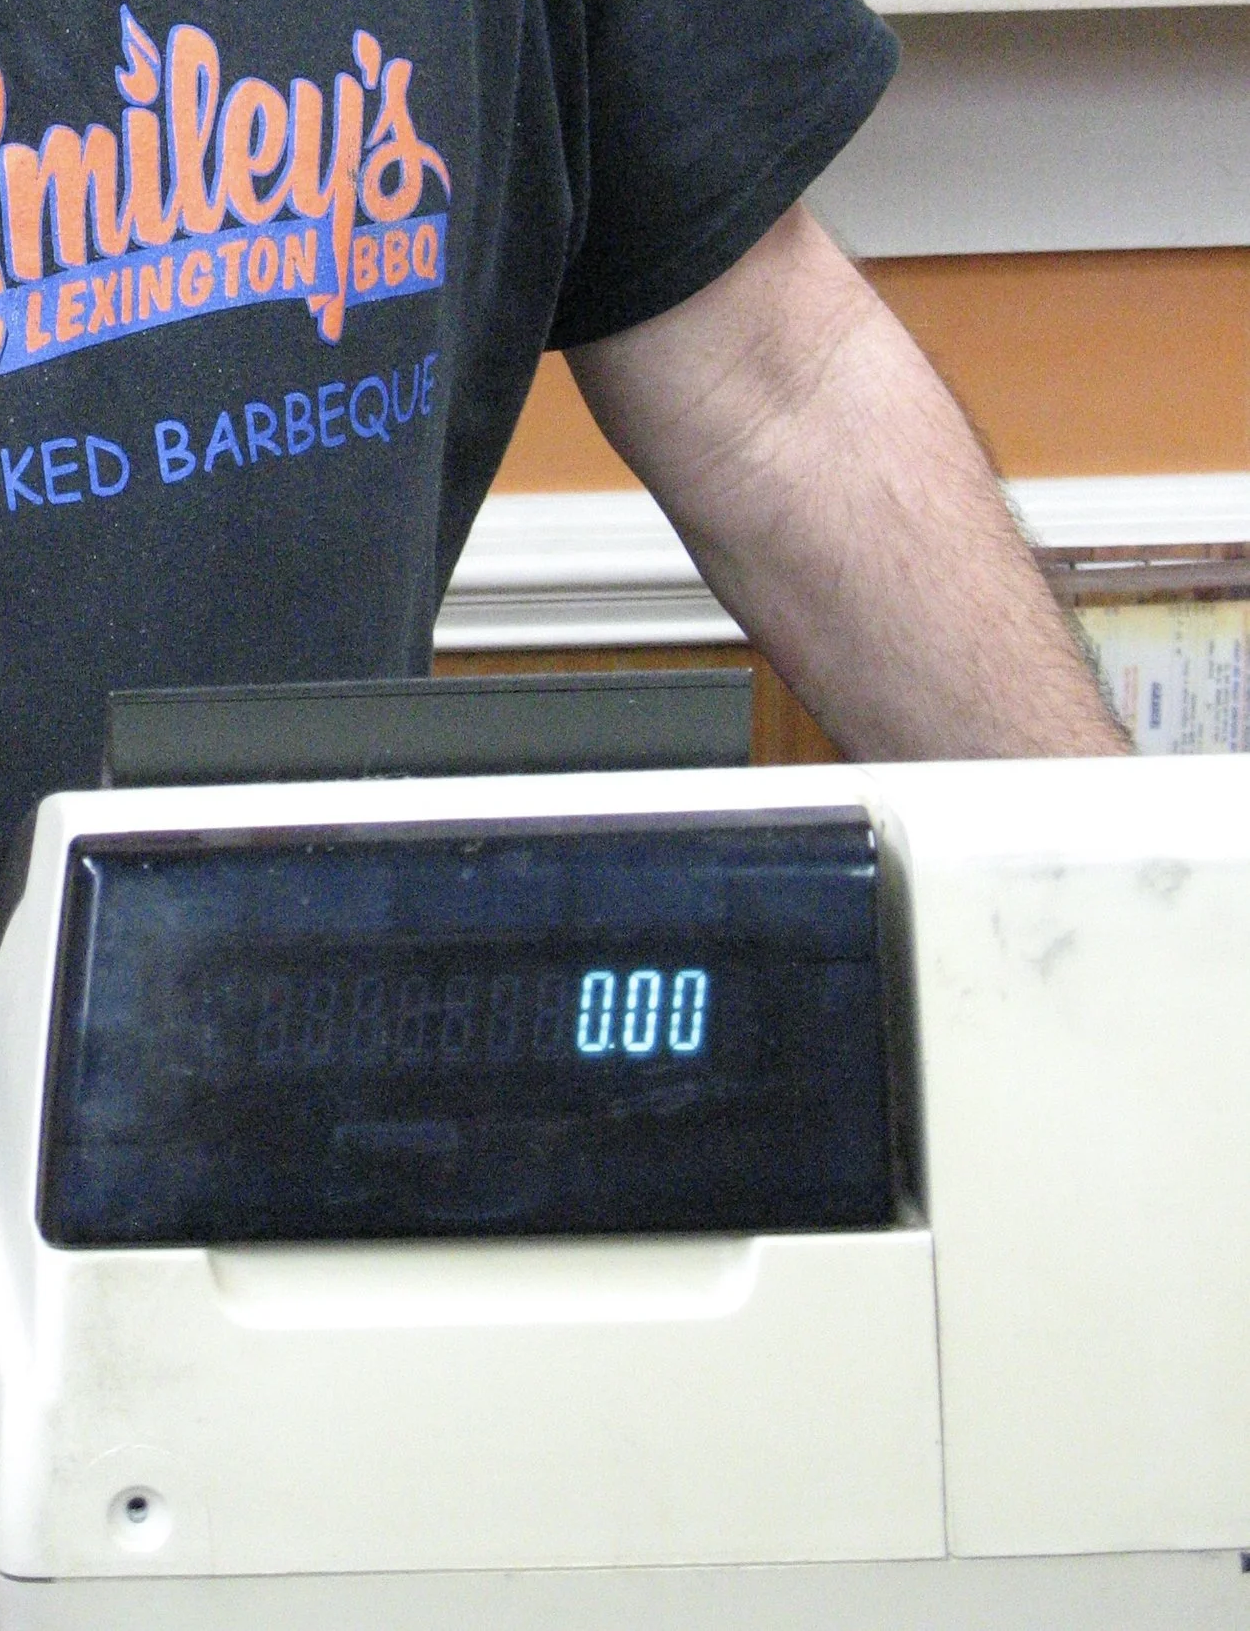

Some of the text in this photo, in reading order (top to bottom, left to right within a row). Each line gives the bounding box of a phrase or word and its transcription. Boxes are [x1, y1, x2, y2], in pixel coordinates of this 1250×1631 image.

[25, 223, 441, 354] LEXINGTON BBQ
[153, 349, 440, 485] BARBEQUE
